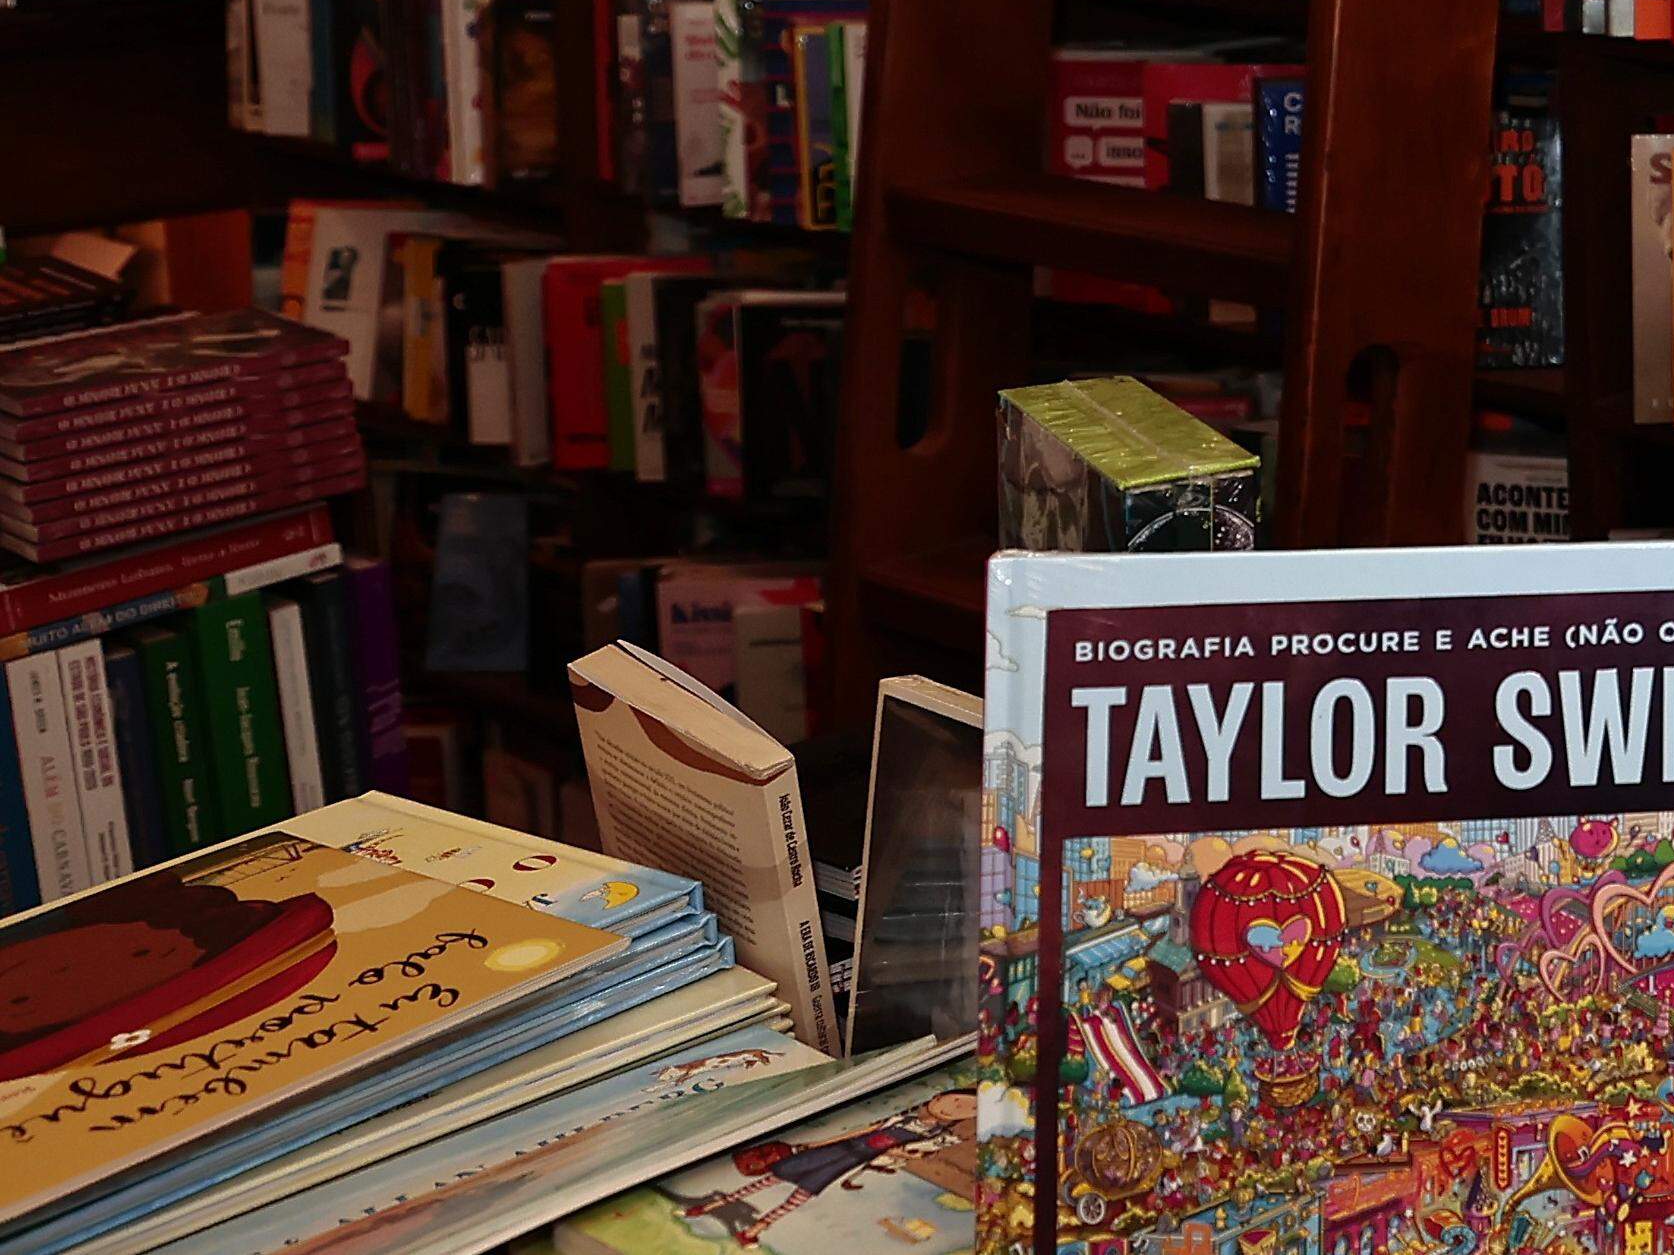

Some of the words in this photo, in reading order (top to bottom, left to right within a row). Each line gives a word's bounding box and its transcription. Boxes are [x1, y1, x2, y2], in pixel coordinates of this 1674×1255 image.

[1477, 484, 1568, 508] ACONTE
[1477, 509, 1529, 532] COM
[1074, 633, 1255, 663] BIOGRAFIA
[1270, 630, 1421, 657] PROCURE
[1434, 630, 1452, 652] E
[1468, 625, 1551, 652] ACHE
[1564, 617, 1643, 648] (NÃO
[1071, 675, 1448, 808] TAYLOR
[348, 929, 489, 988] falo
[379, 982, 460, 1017] Eu
[0, 988, 340, 1144] portuguê
